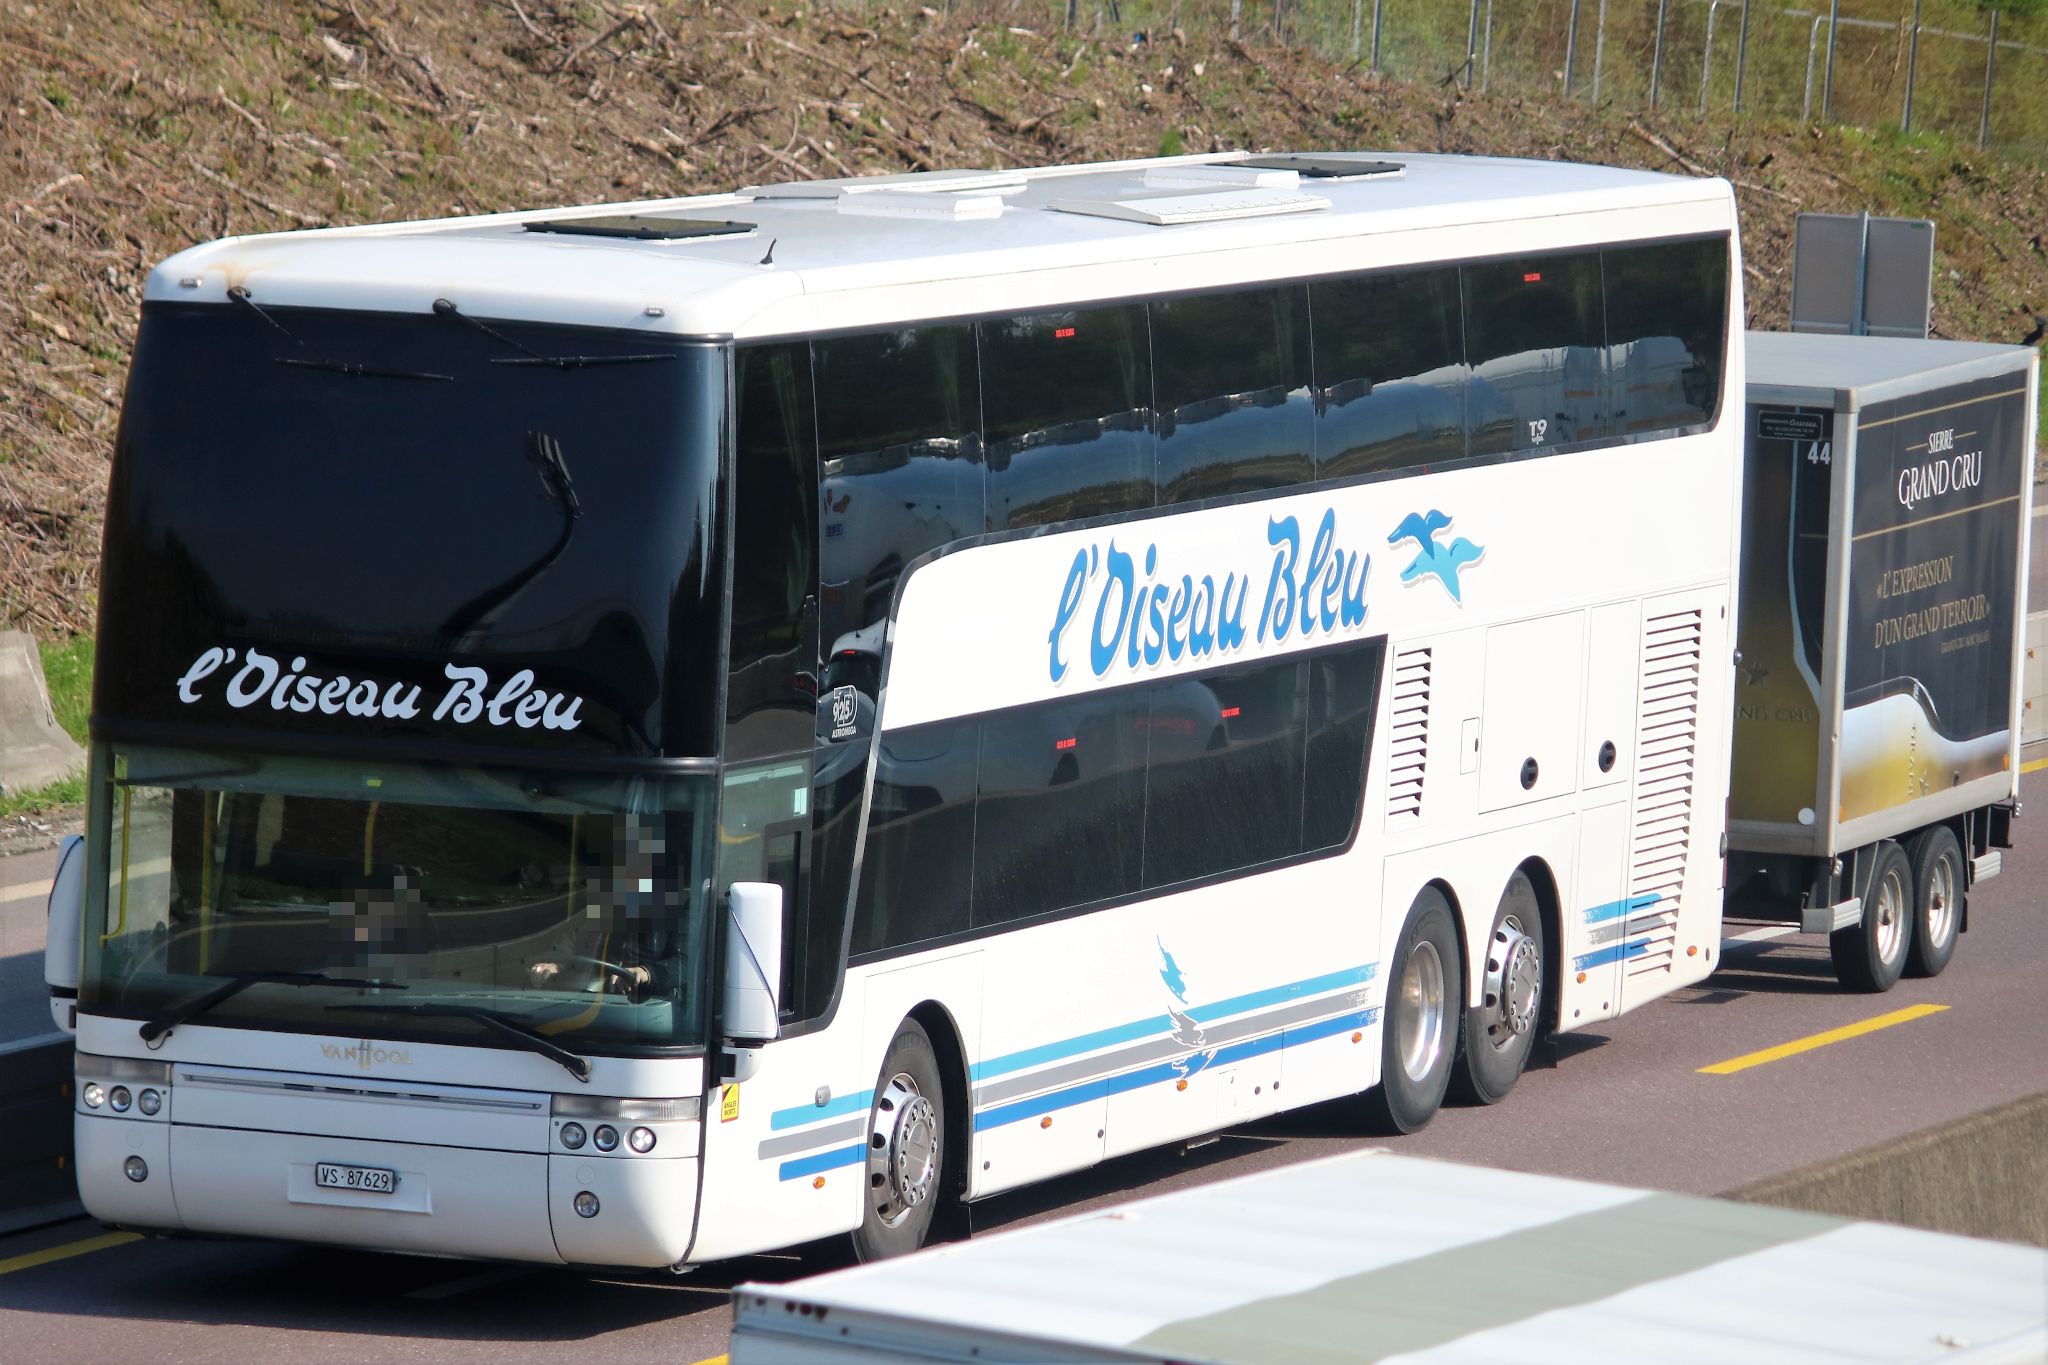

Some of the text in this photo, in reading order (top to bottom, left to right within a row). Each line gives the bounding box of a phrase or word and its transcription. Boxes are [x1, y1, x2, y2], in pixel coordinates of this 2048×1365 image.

[1529, 419, 1547, 436] T9
[1928, 428, 1954, 454] SIERRE
[1807, 441, 1831, 464] 44
[1899, 451, 1983, 510] GRAND CRU
[1047, 506, 1372, 683] l'Oiseau Bleu
[1903, 606, 1940, 640] GRAND
[177, 646, 583, 731] l'Oiseau Bleu
